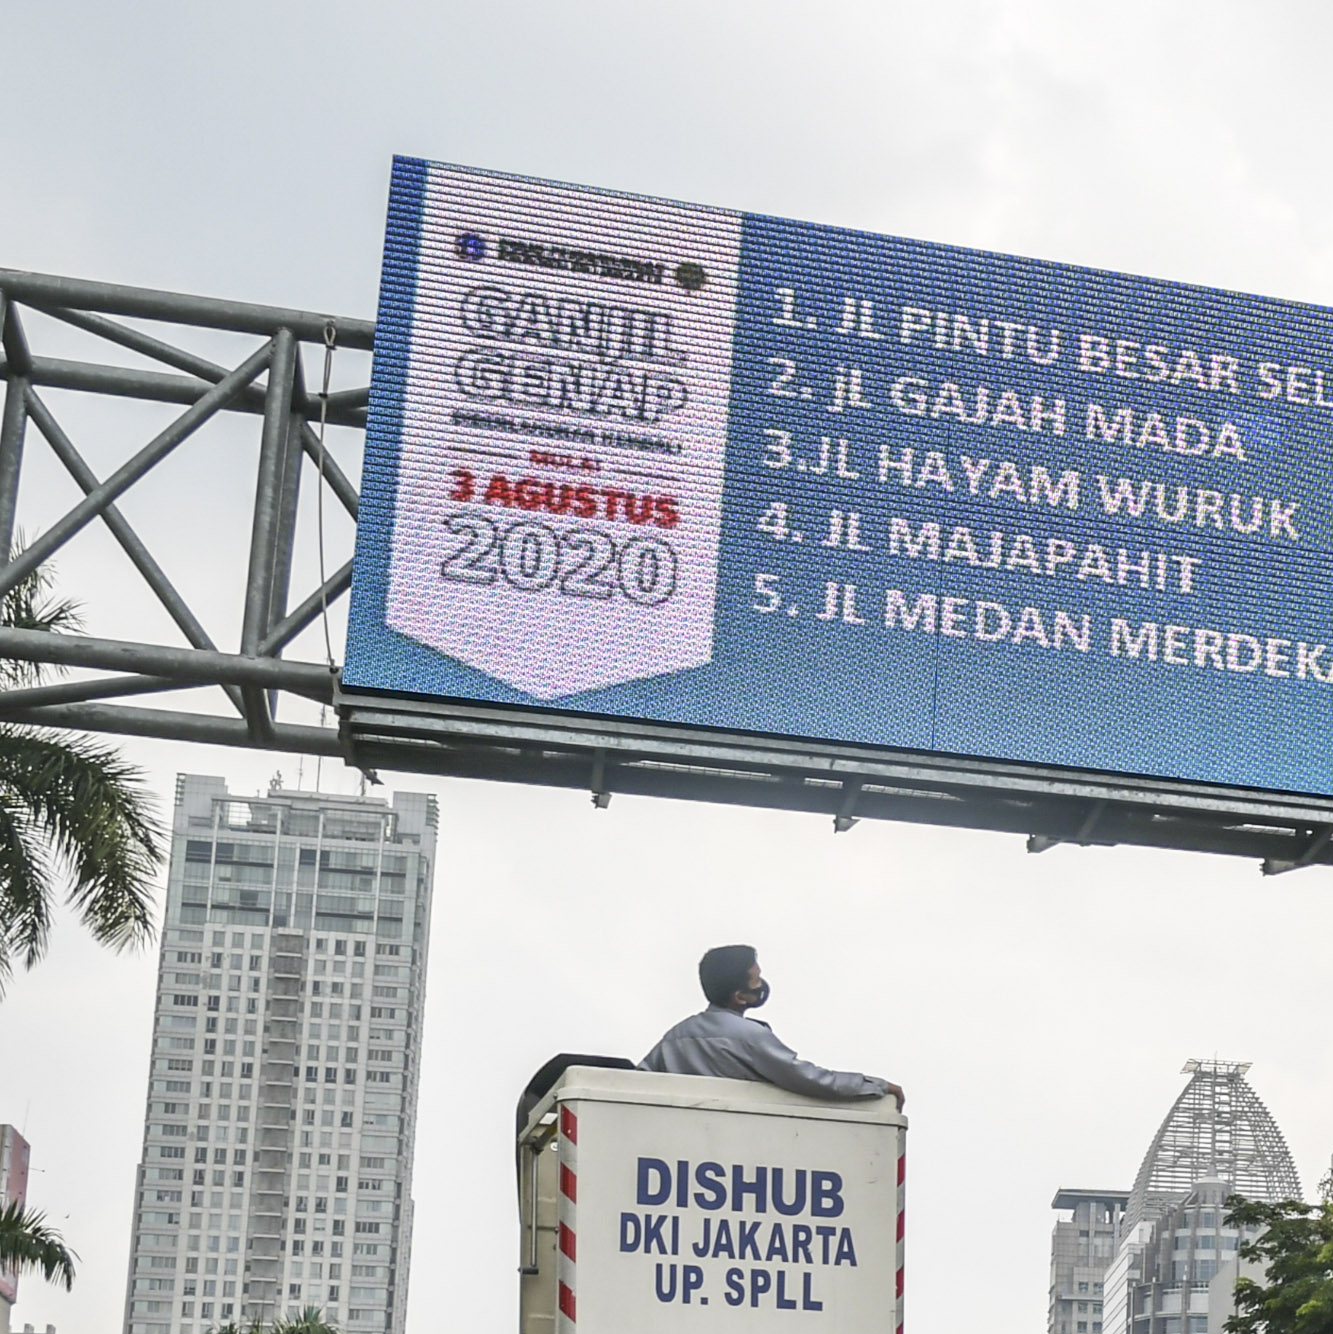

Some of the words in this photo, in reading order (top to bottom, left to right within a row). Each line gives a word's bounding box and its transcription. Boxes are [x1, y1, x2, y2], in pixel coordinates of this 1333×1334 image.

[773, 287, 816, 330] 1.
[835, 298, 882, 341] JL
[900, 306, 1061, 367] PINTU
[1079, 333, 1240, 395] BESAR
[454, 346, 688, 424] GENAP
[769, 356, 812, 402] 2.
[890, 376, 1067, 436] GAJAH
[1086, 402, 1248, 462] MADA
[448, 467, 475, 504] 3
[483, 473, 681, 529] AGUSTUS
[879, 442, 1079, 510] HAYAM
[1098, 473, 1301, 541] WURUK
[440, 511, 679, 607] 2020
[758, 500, 803, 545] 4.
[822, 508, 870, 553] JL
[889, 516, 1201, 596] MAJAPAHIT
[752, 572, 797, 619] 5.
[817, 580, 864, 627] JL
[884, 588, 1093, 655] MEDAN
[636, 1156, 845, 1218] DISHUB
[619, 1212, 680, 1257] DKI
[692, 1217, 858, 1267] JAKARTA
[655, 1263, 708, 1306] UP.
[723, 1266, 824, 1312] SPLL
